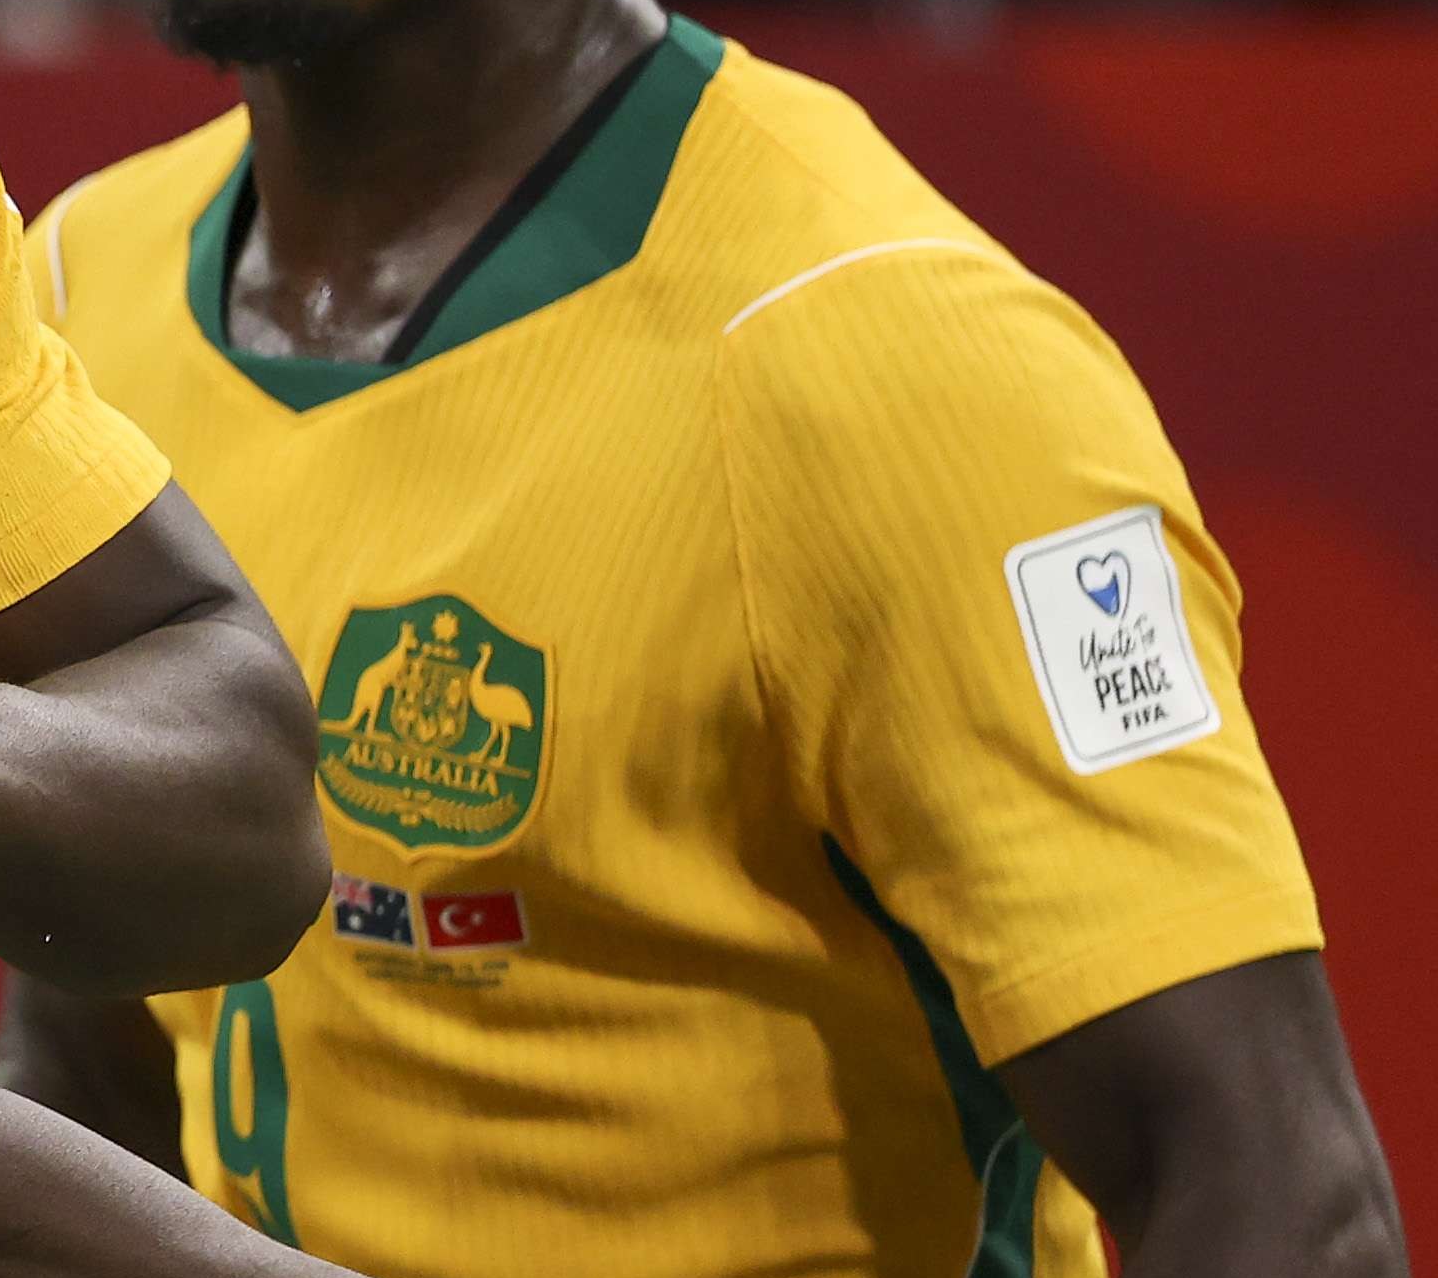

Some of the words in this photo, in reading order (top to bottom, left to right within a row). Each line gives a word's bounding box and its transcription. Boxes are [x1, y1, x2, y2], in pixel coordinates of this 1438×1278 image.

[1095, 656, 1173, 712] PEACE
[1122, 702, 1168, 732] FIFA
[342, 740, 499, 797] AUSTRALIA
[213, 978, 304, 1252] 9
